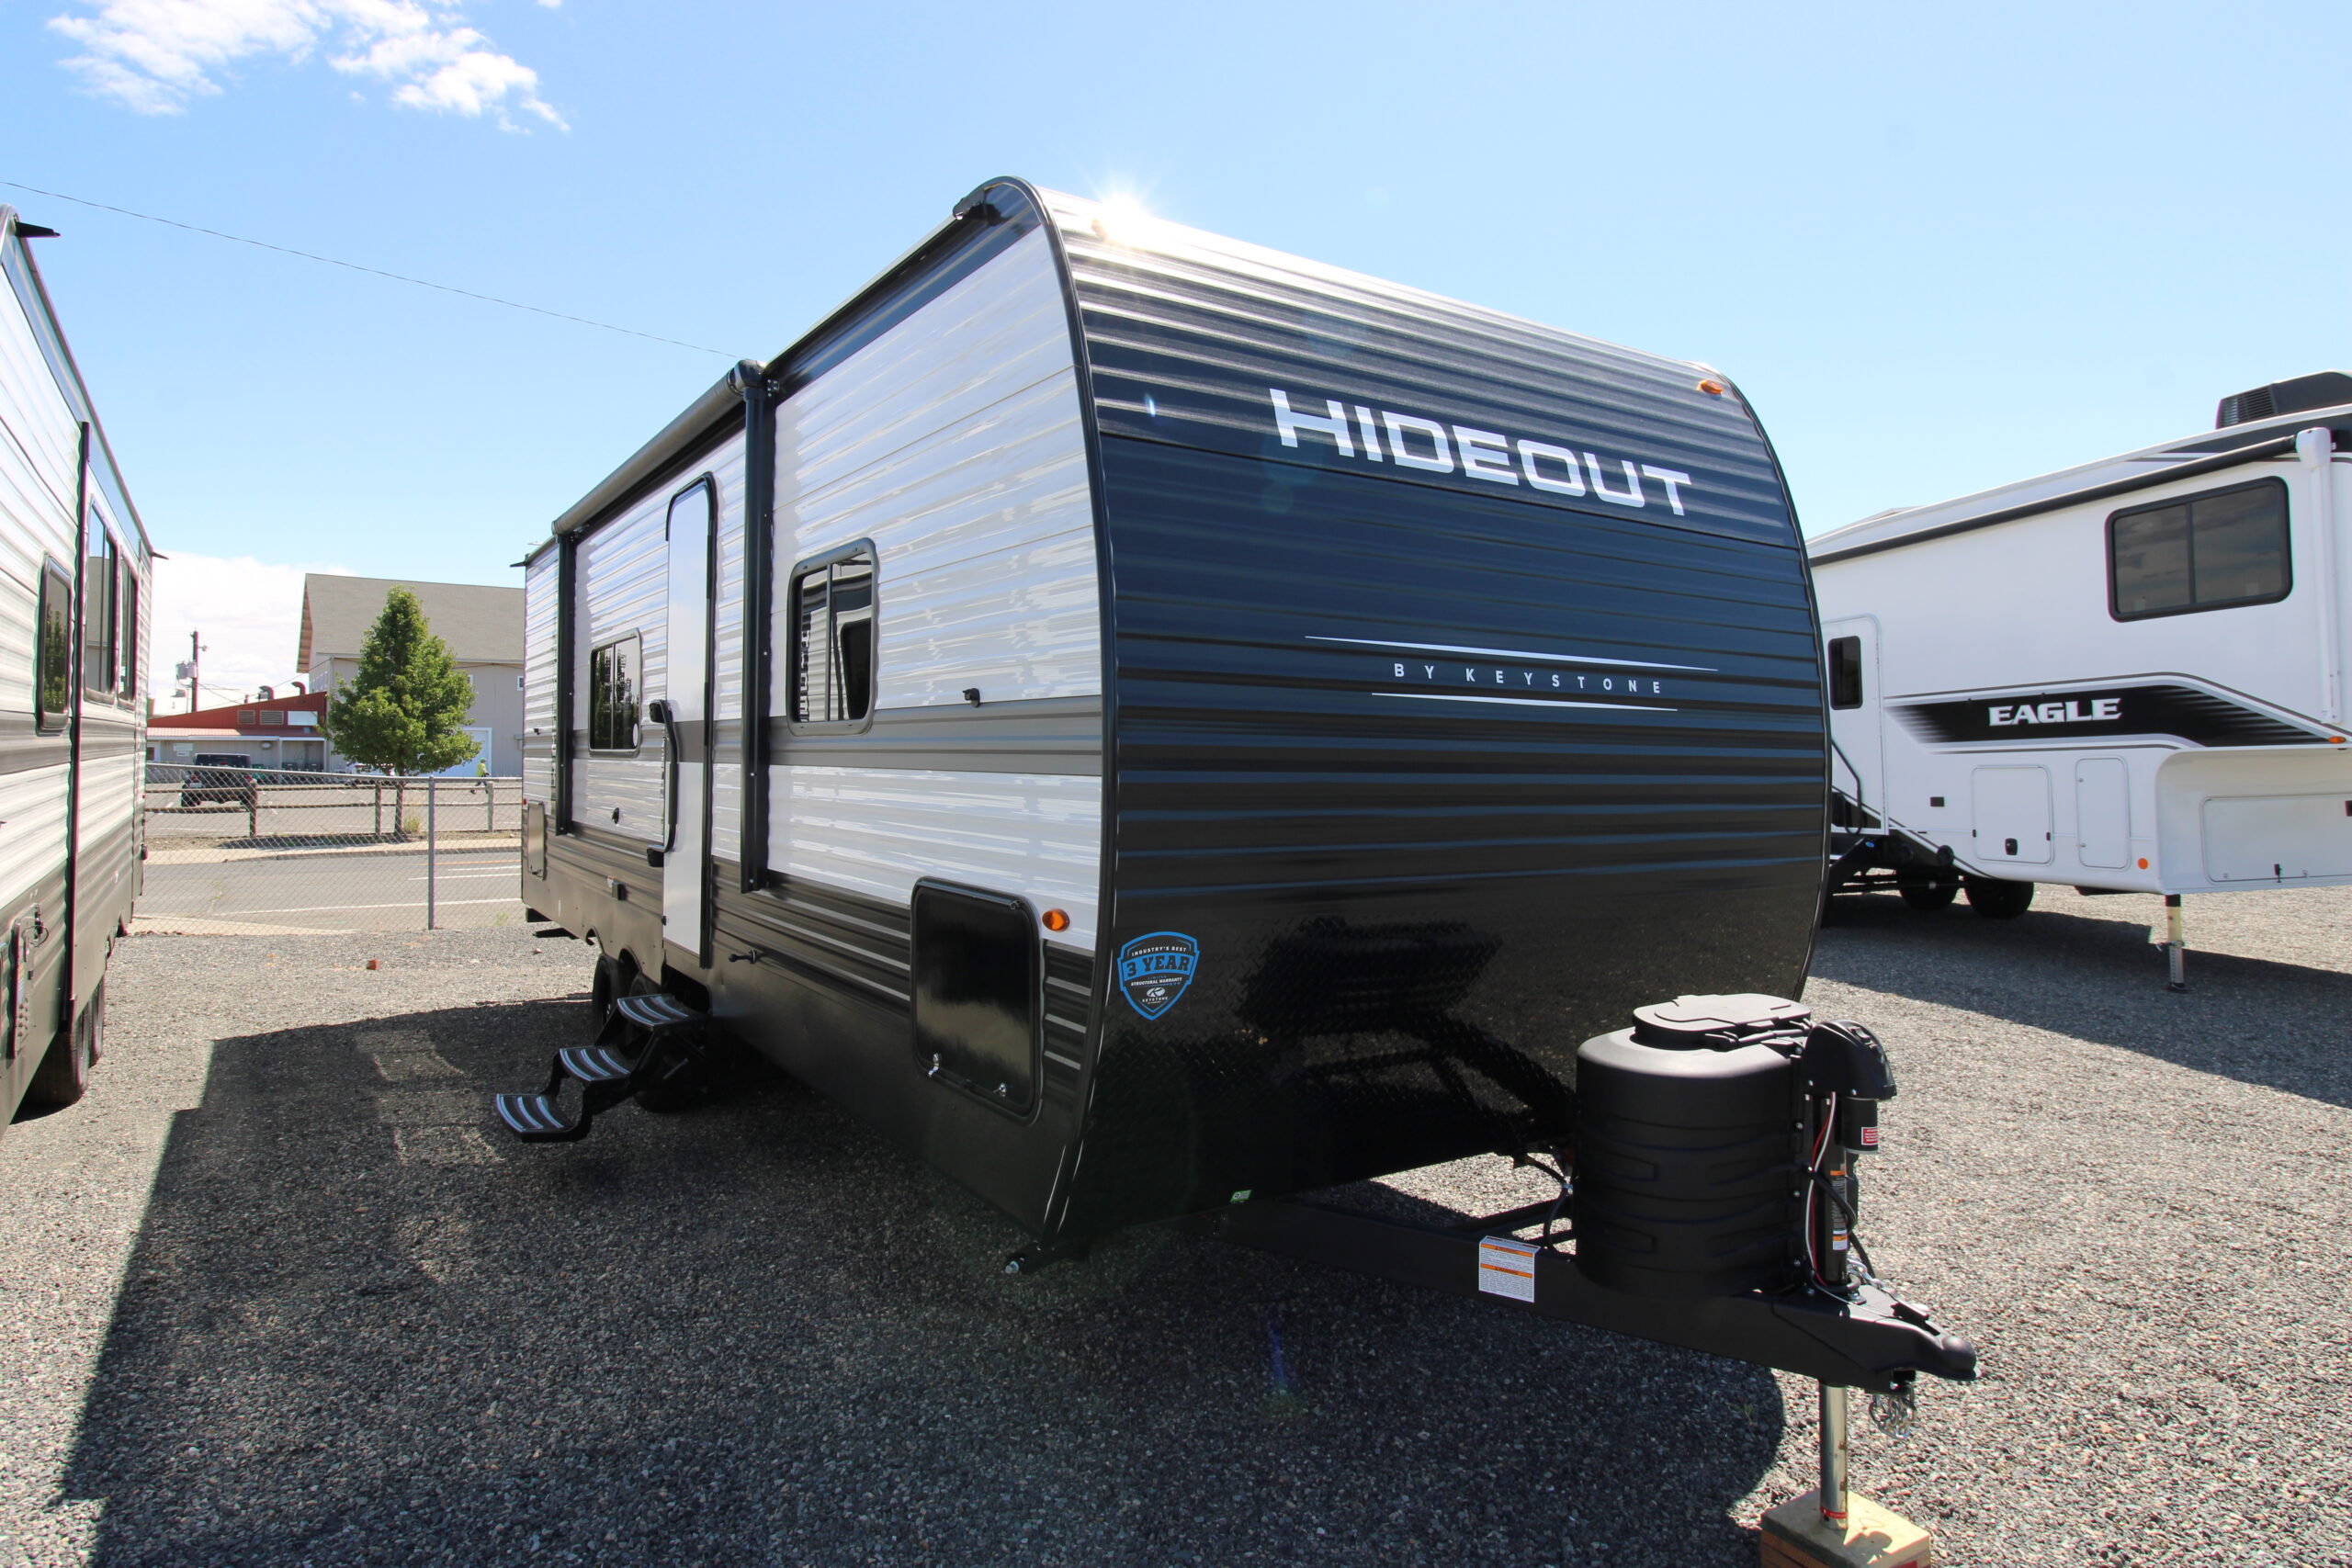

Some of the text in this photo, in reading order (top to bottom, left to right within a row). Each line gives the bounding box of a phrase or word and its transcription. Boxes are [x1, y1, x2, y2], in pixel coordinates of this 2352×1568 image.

[1270, 388, 1692, 516] HIDEOUT
[1394, 662, 1660, 694] BY KEYSTONE
[1988, 697, 2122, 727] EAGLE
[1126, 955, 1190, 977] 3 YEAR
[1132, 946, 1170, 956] INDUSTRY'S
